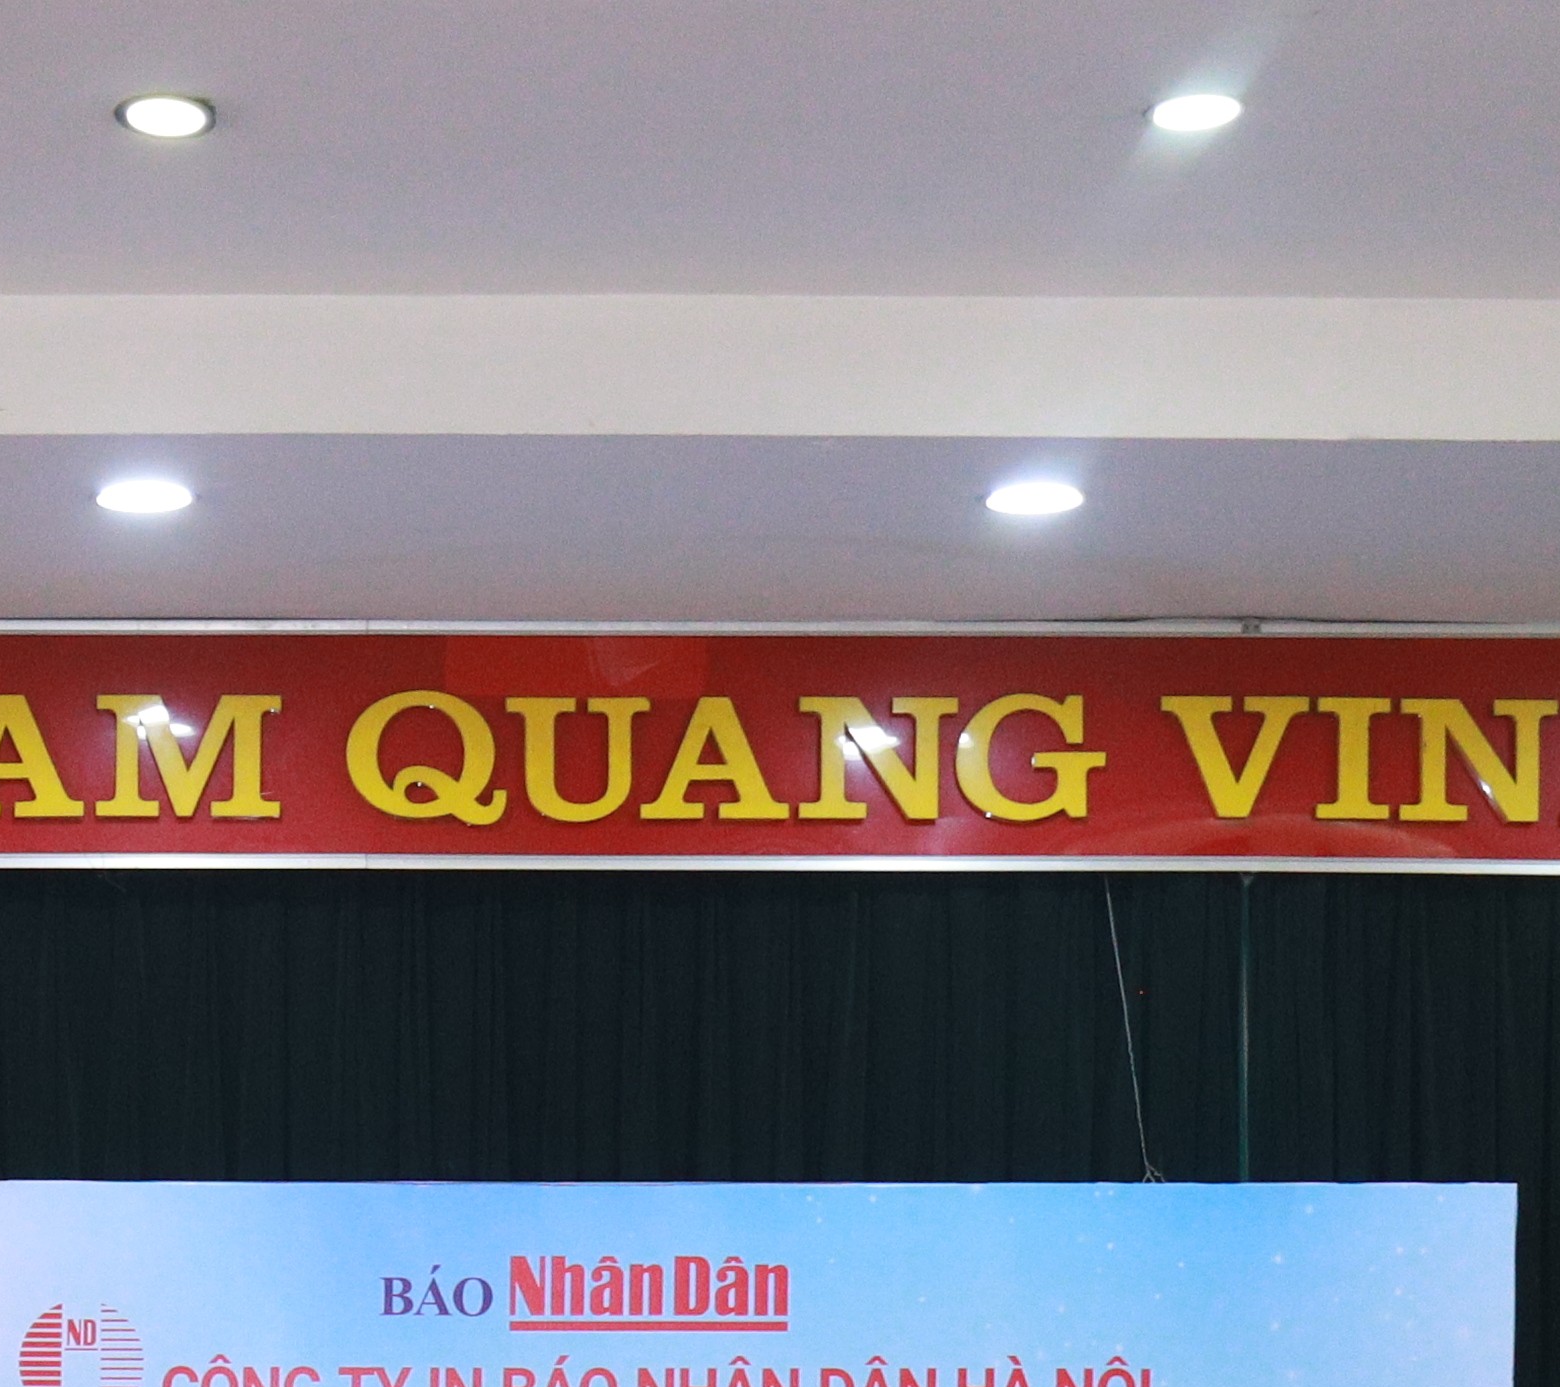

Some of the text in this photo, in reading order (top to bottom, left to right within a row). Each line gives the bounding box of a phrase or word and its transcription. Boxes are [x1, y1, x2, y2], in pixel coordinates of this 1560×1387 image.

[346, 690, 1108, 826] QUANG
[381, 1255, 789, 1316] BÁO Nhân Dân
[66, 1319, 97, 1346] ND
